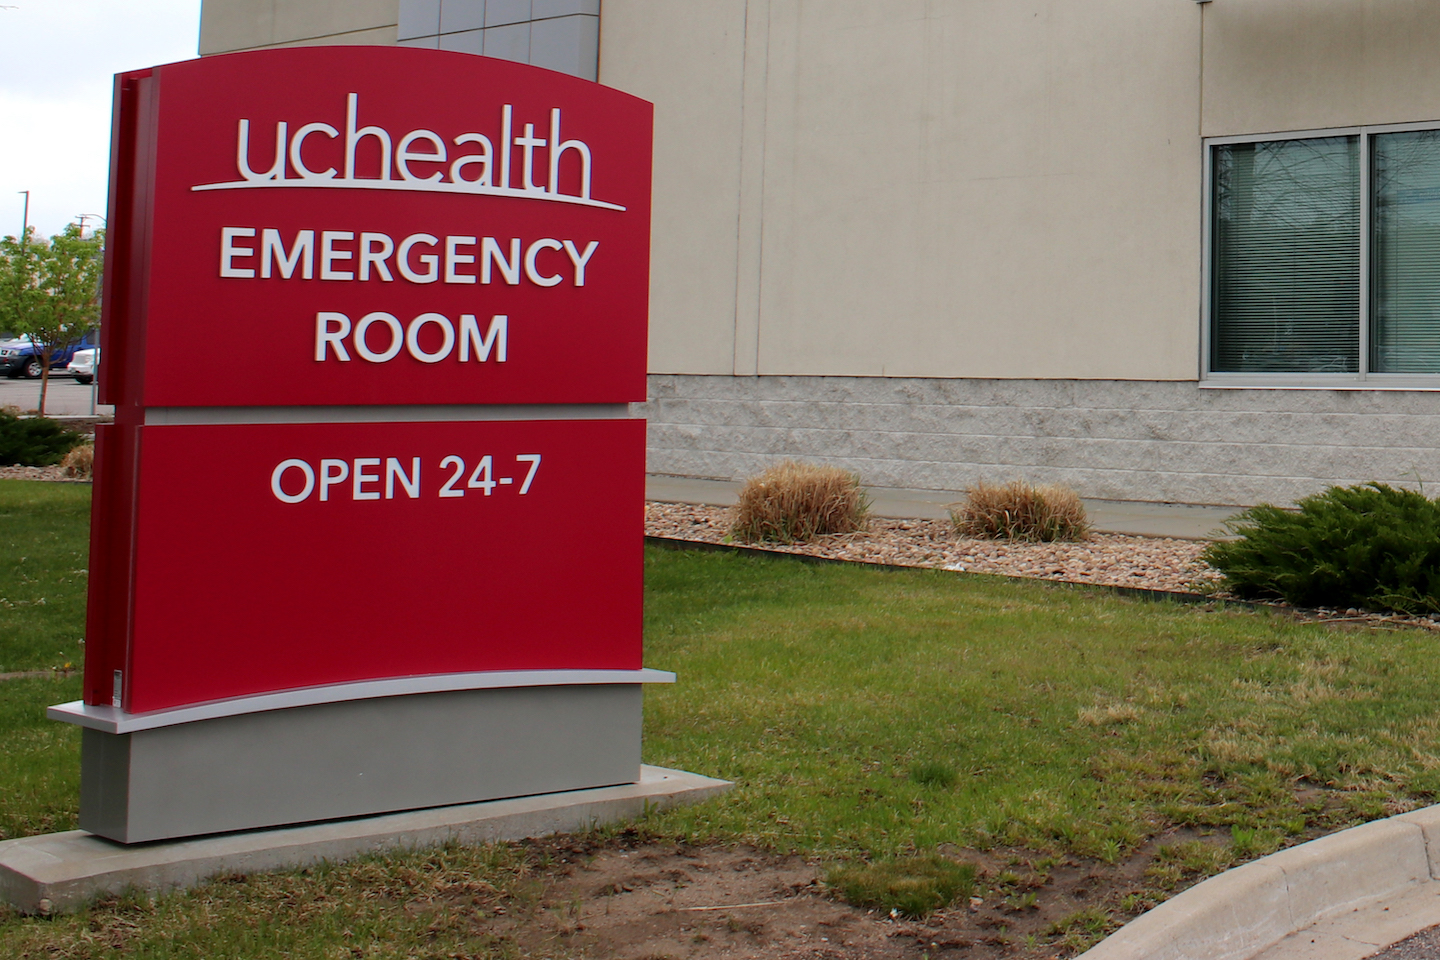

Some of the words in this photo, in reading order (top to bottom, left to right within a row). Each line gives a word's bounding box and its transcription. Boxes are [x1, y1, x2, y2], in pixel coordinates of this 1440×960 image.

[236, 92, 593, 200] uchealth
[218, 226, 600, 287] EMERGENCY
[314, 311, 509, 364] ROOM
[270, 456, 421, 503] OPEN
[438, 453, 543, 498] 24-7
